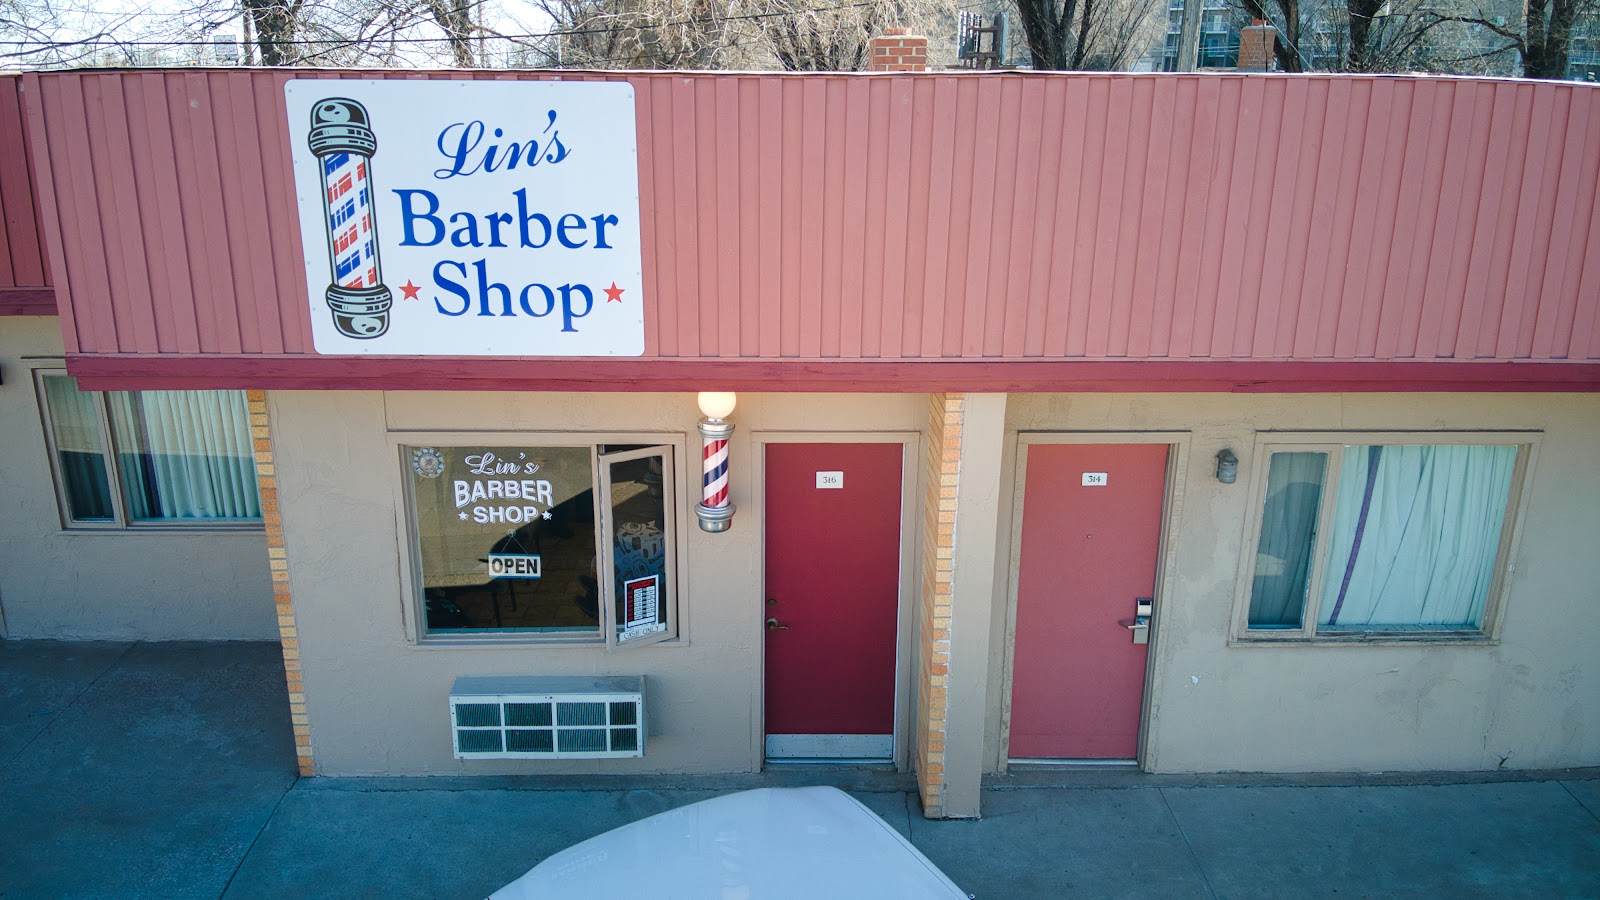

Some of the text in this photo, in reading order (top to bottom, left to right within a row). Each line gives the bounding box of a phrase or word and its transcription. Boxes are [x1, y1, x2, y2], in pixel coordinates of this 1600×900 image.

[434, 109, 571, 180] Lin's
[391, 187, 619, 249] Barber
[432, 258, 594, 332] Shop
[464, 452, 540, 476] Lin's
[822, 476, 837, 484] 316
[1087, 475, 1101, 483] 314
[453, 480, 554, 508] BARBER
[473, 506, 539, 523] SHOP
[491, 558, 538, 574] OPEN
